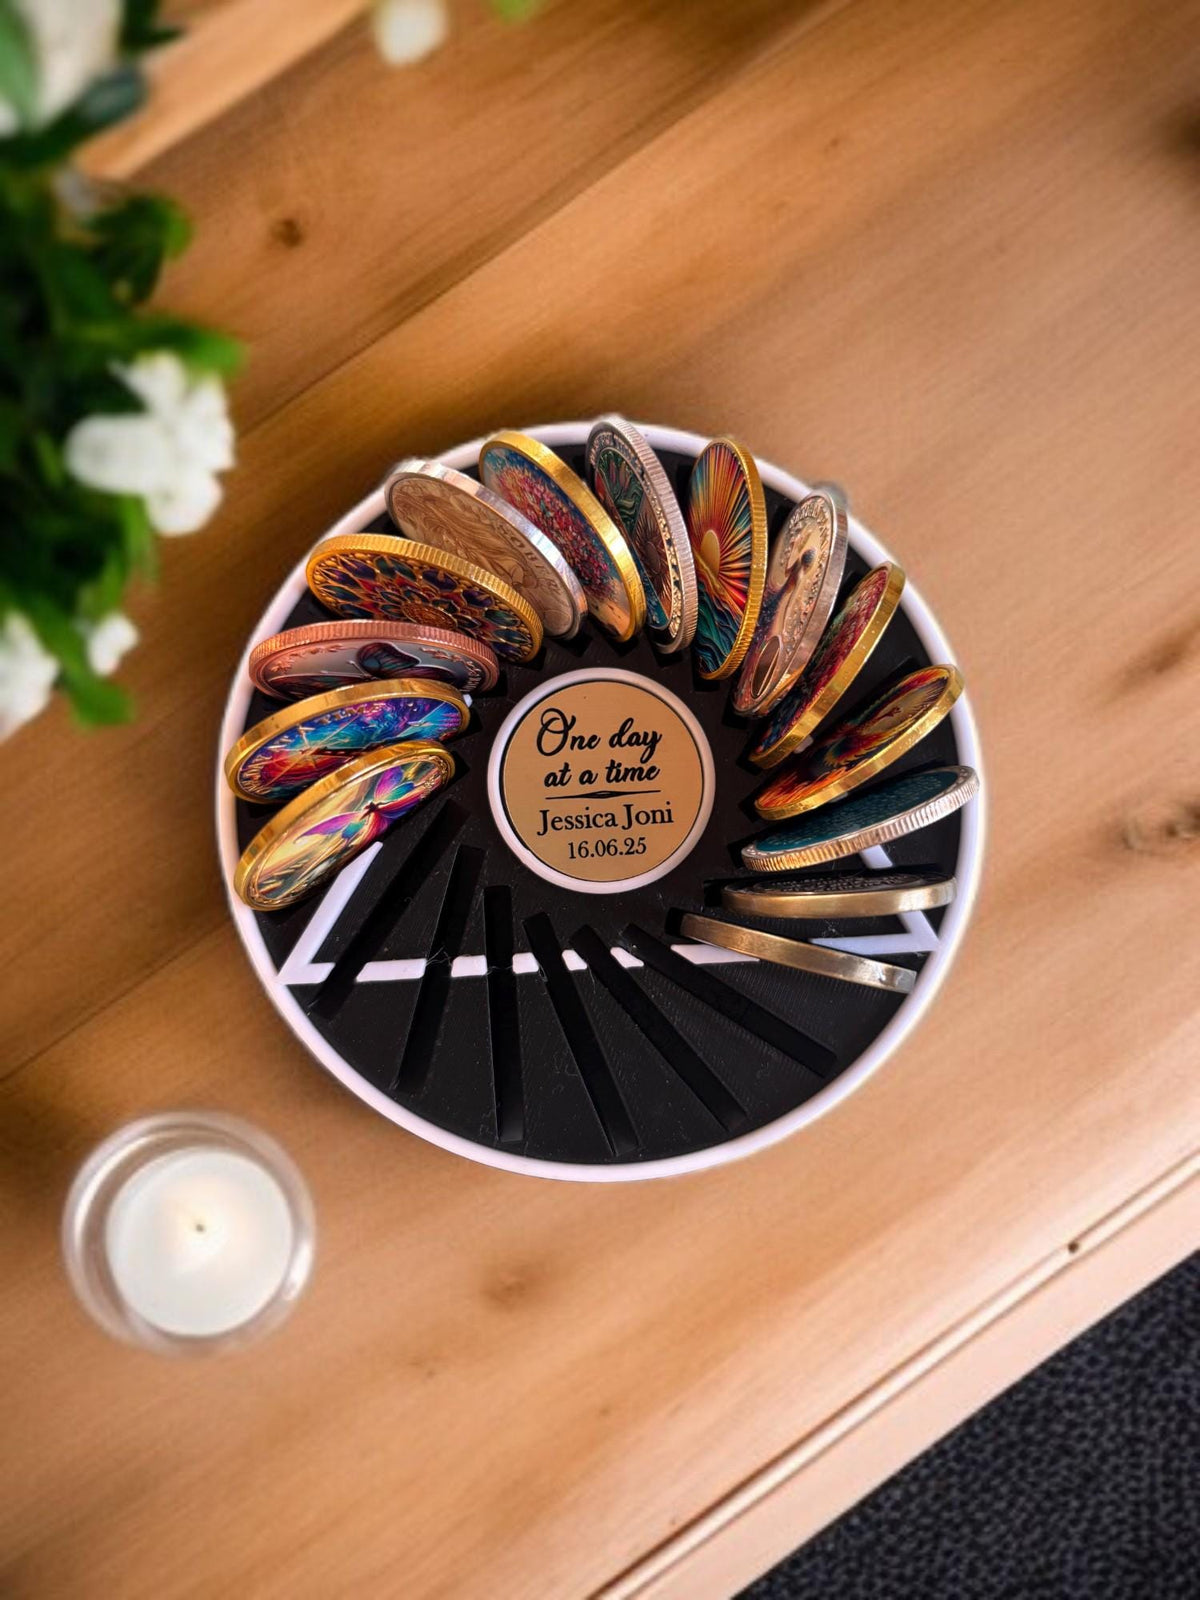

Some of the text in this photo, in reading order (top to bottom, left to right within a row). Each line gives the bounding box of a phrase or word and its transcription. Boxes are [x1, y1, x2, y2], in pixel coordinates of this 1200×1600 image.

[536, 707, 662, 764] One day
[543, 759, 661, 787] at a time
[536, 800, 674, 836] Jessica Joni
[567, 836, 647, 859] 16.06.25
